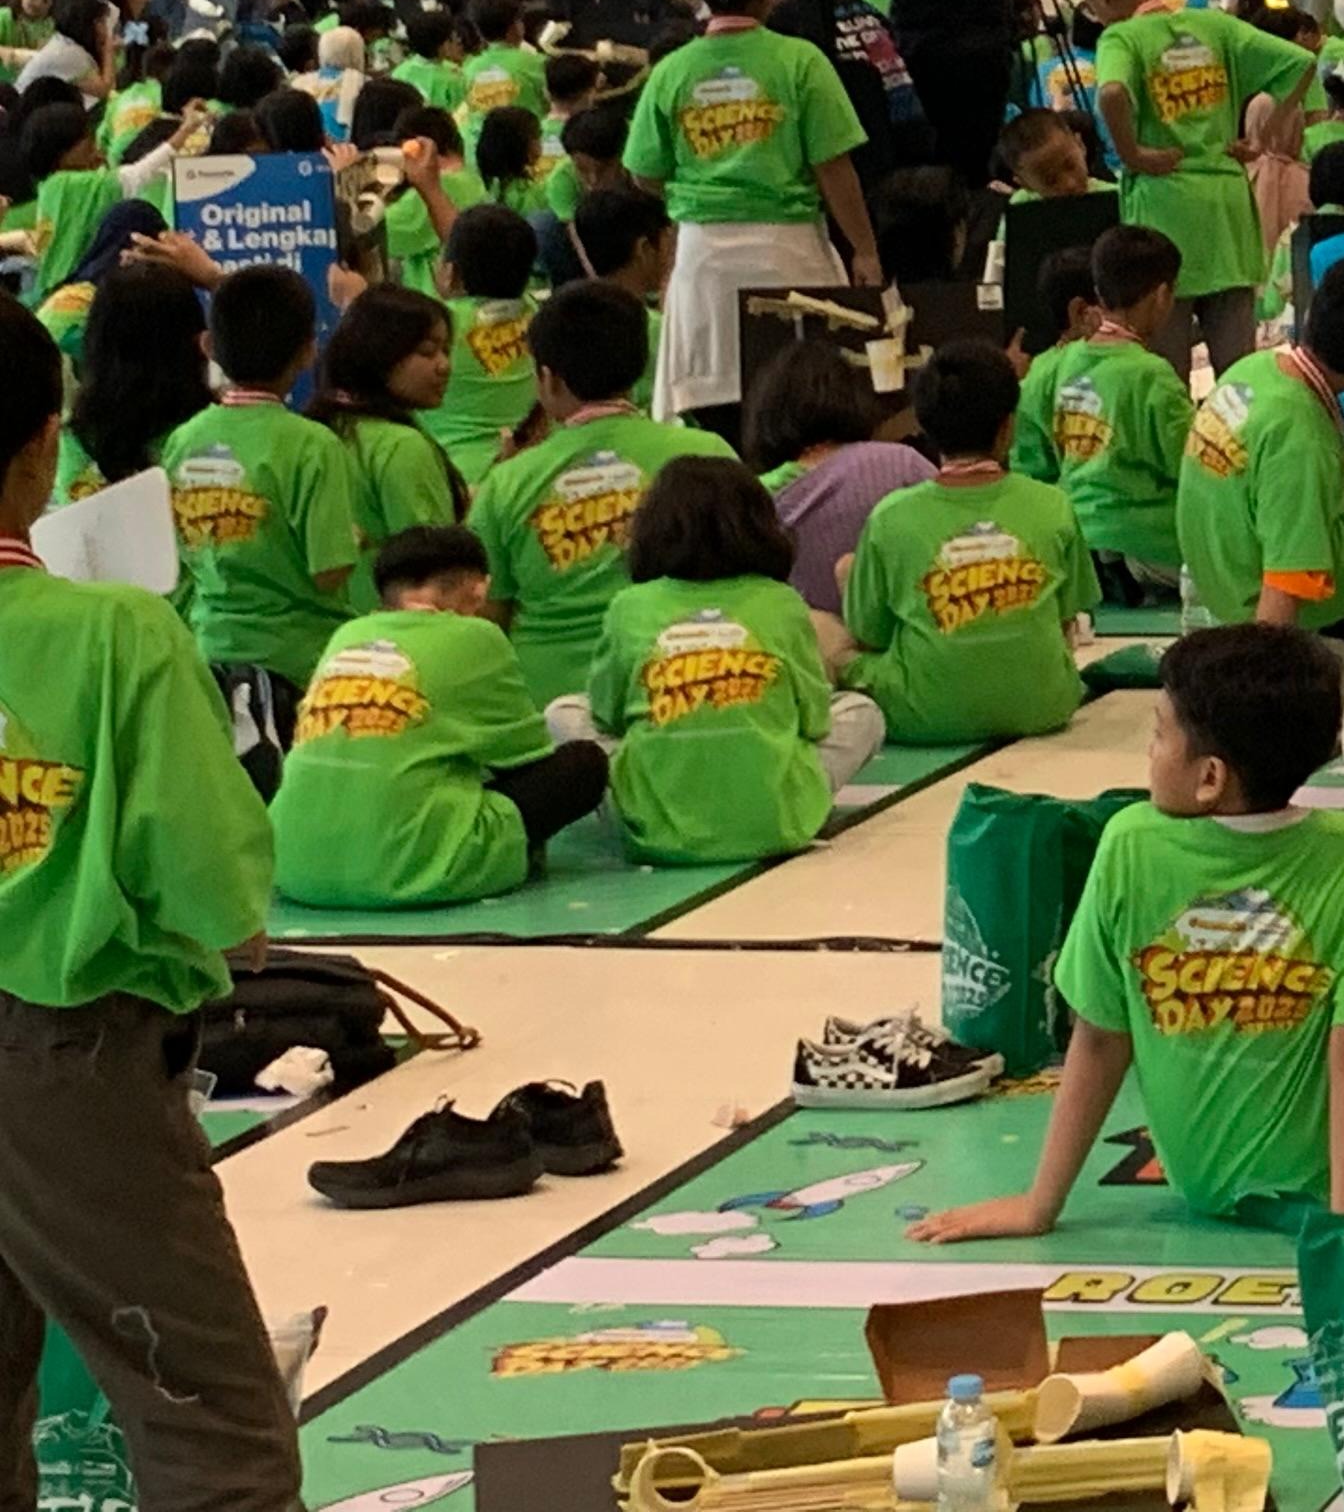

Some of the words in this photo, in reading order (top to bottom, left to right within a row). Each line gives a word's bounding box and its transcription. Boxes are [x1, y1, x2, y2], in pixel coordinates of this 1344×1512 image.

[201, 199, 312, 228] Original
[203, 228, 223, 252] &
[536, 490, 641, 535] SCIEN
[645, 649, 783, 693] SCIENCE
[1138, 944, 1332, 1001] SCIENCE
[1154, 996, 1232, 1037] DAY
